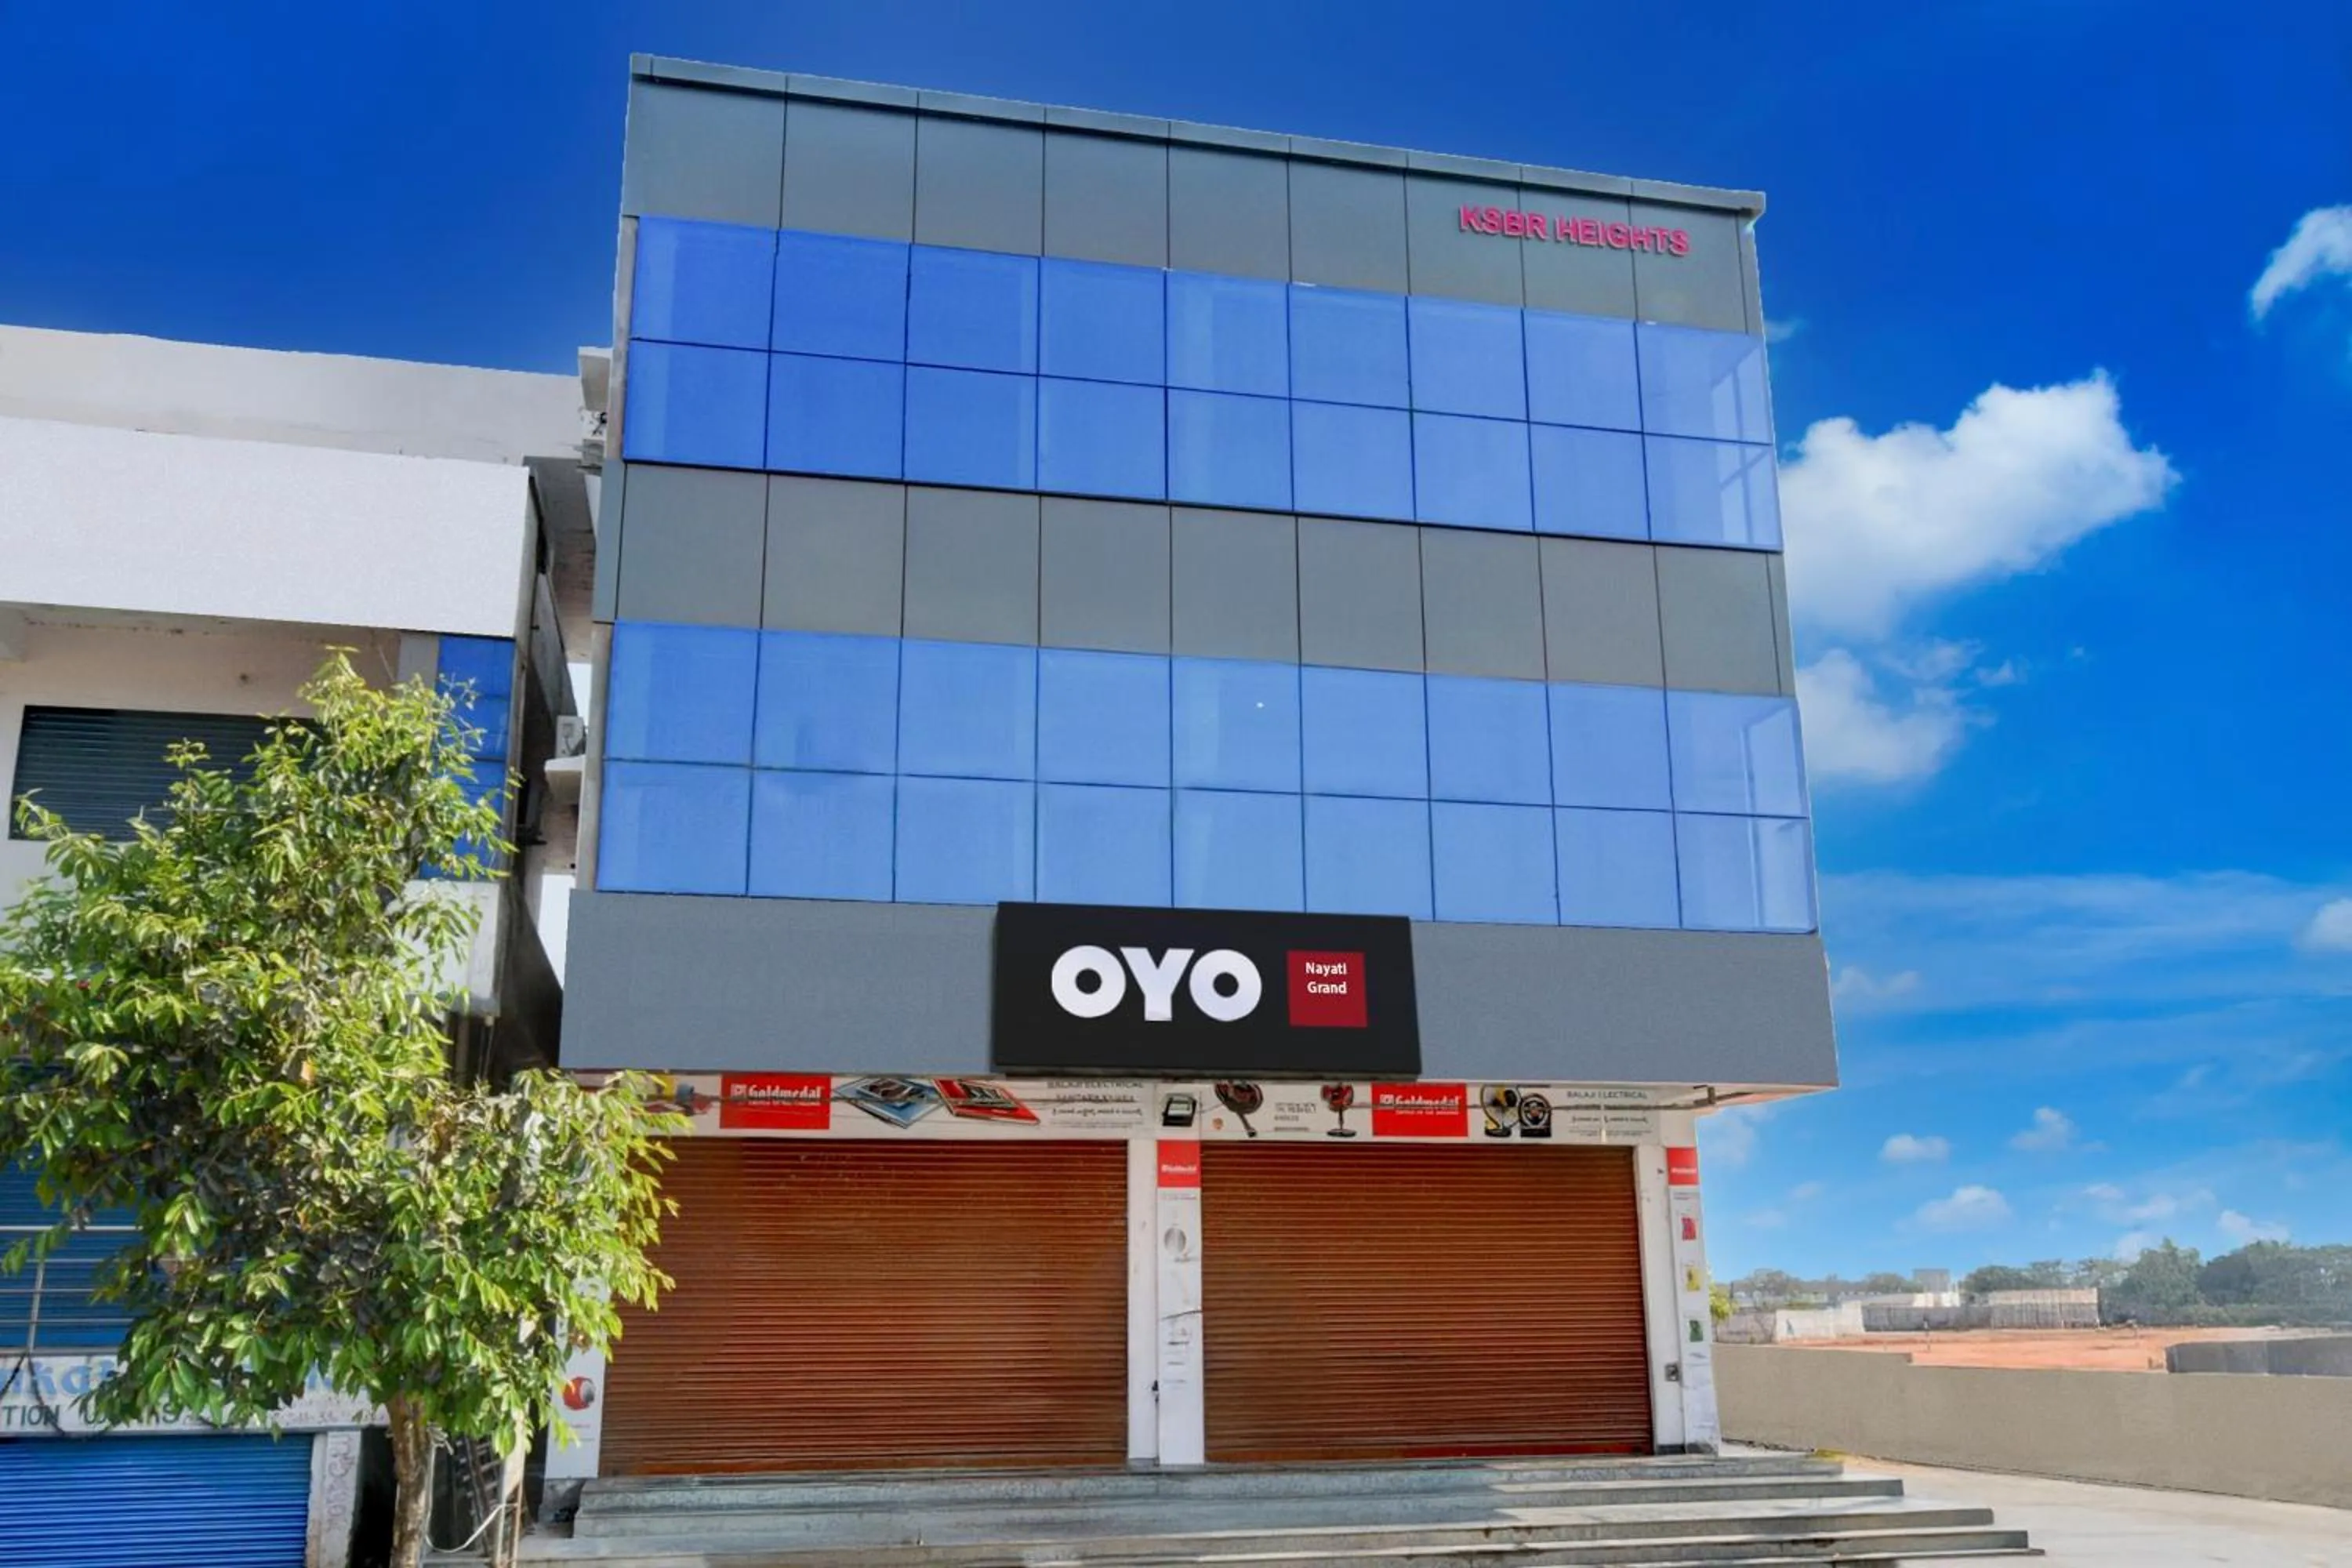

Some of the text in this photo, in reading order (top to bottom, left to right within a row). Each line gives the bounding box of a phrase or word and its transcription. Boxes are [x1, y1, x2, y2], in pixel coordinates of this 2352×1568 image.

[1460, 204, 1690, 256] KSBR HEIGHTS
[1051, 946, 1262, 1022] OYO
[1305, 962, 1347, 977] Nayati
[1307, 981, 1347, 994] Grand
